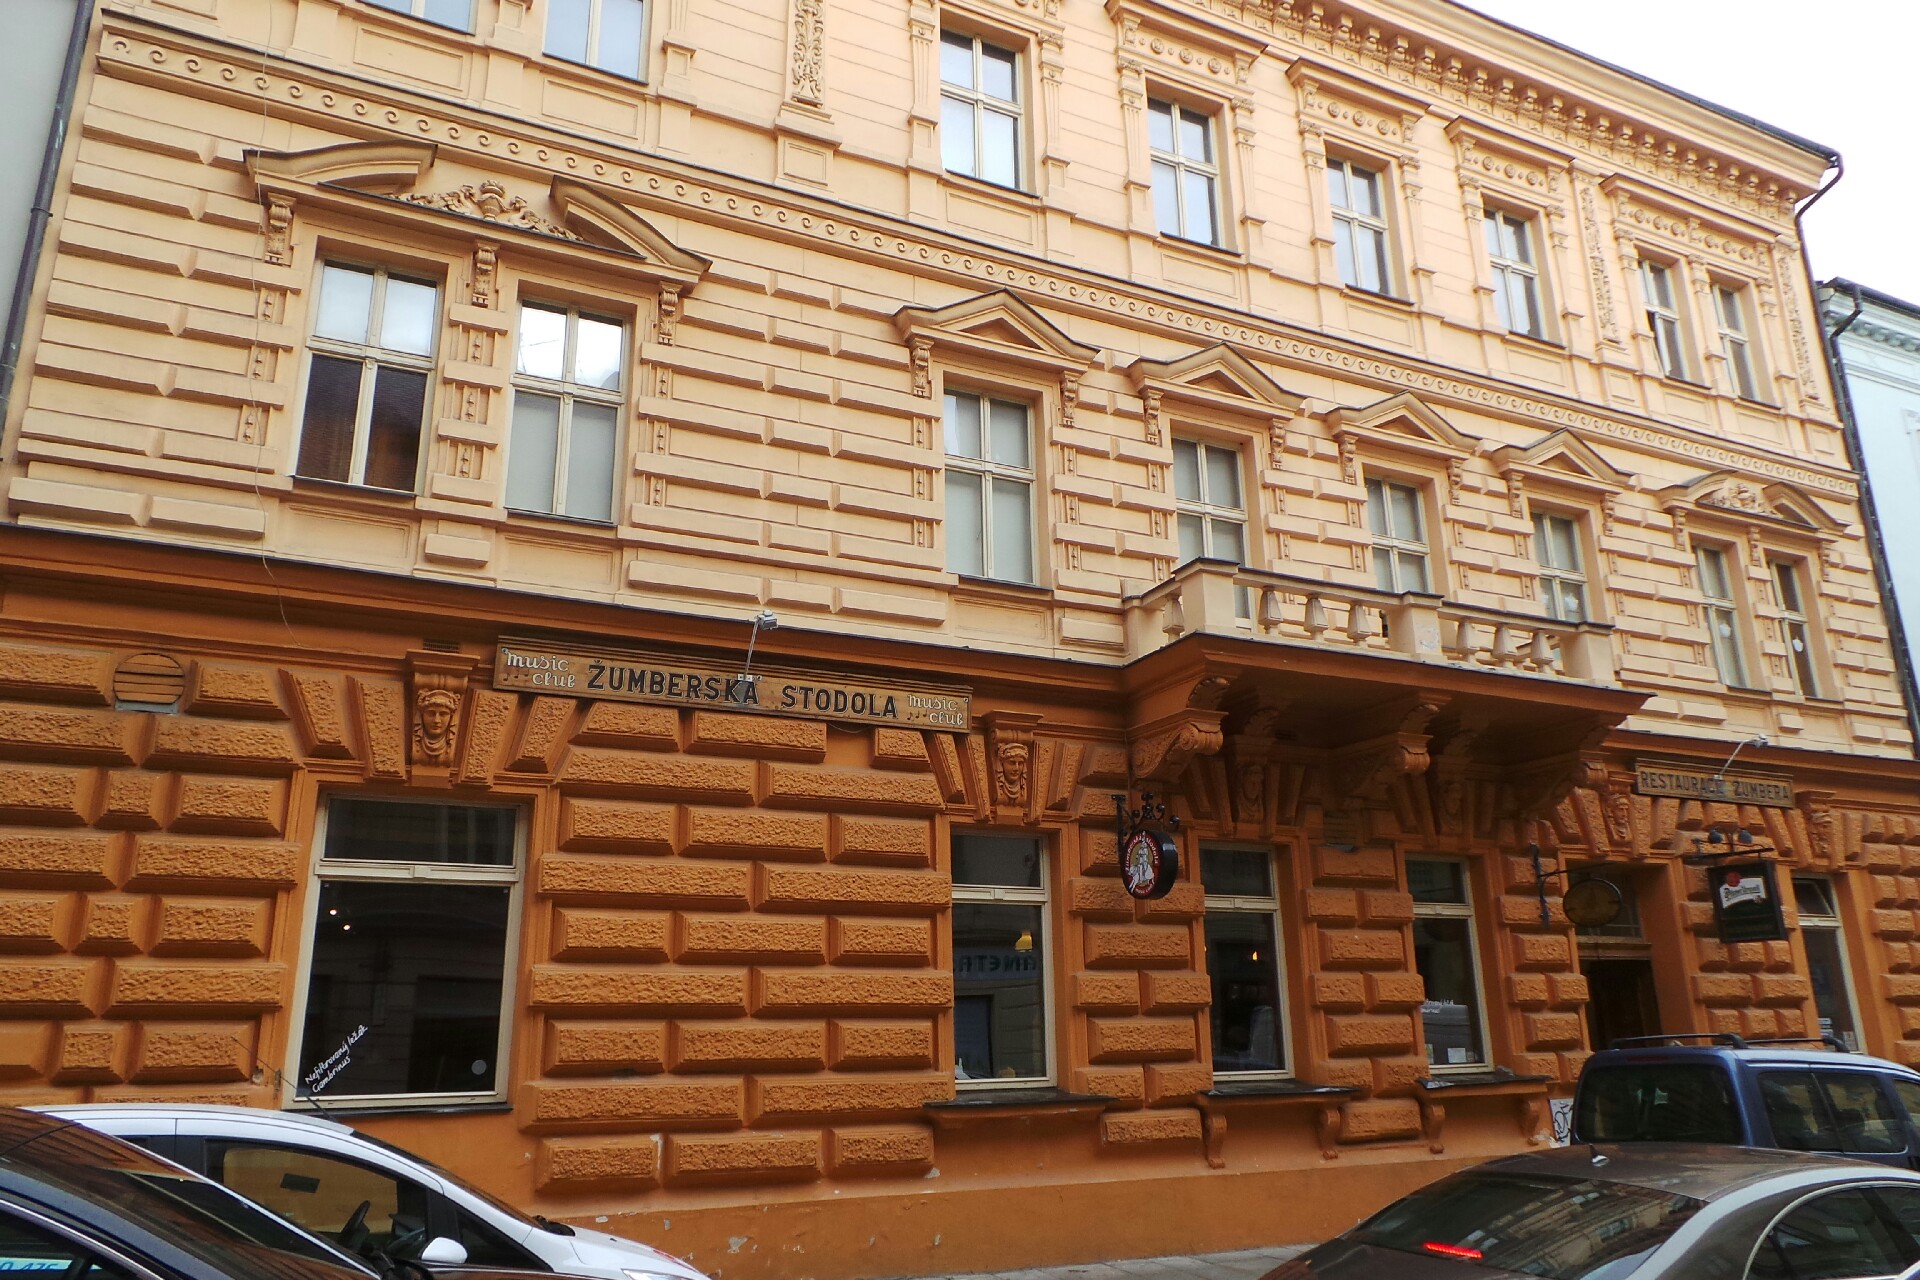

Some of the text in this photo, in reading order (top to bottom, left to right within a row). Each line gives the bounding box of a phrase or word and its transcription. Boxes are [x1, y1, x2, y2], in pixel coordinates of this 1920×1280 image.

[506, 650, 569, 672] music
[532, 671, 576, 688] club
[781, 684, 898, 720] STODOLA
[907, 694, 958, 711] music
[929, 711, 964, 726] club
[312, 1056, 351, 1093] Gambrinus
